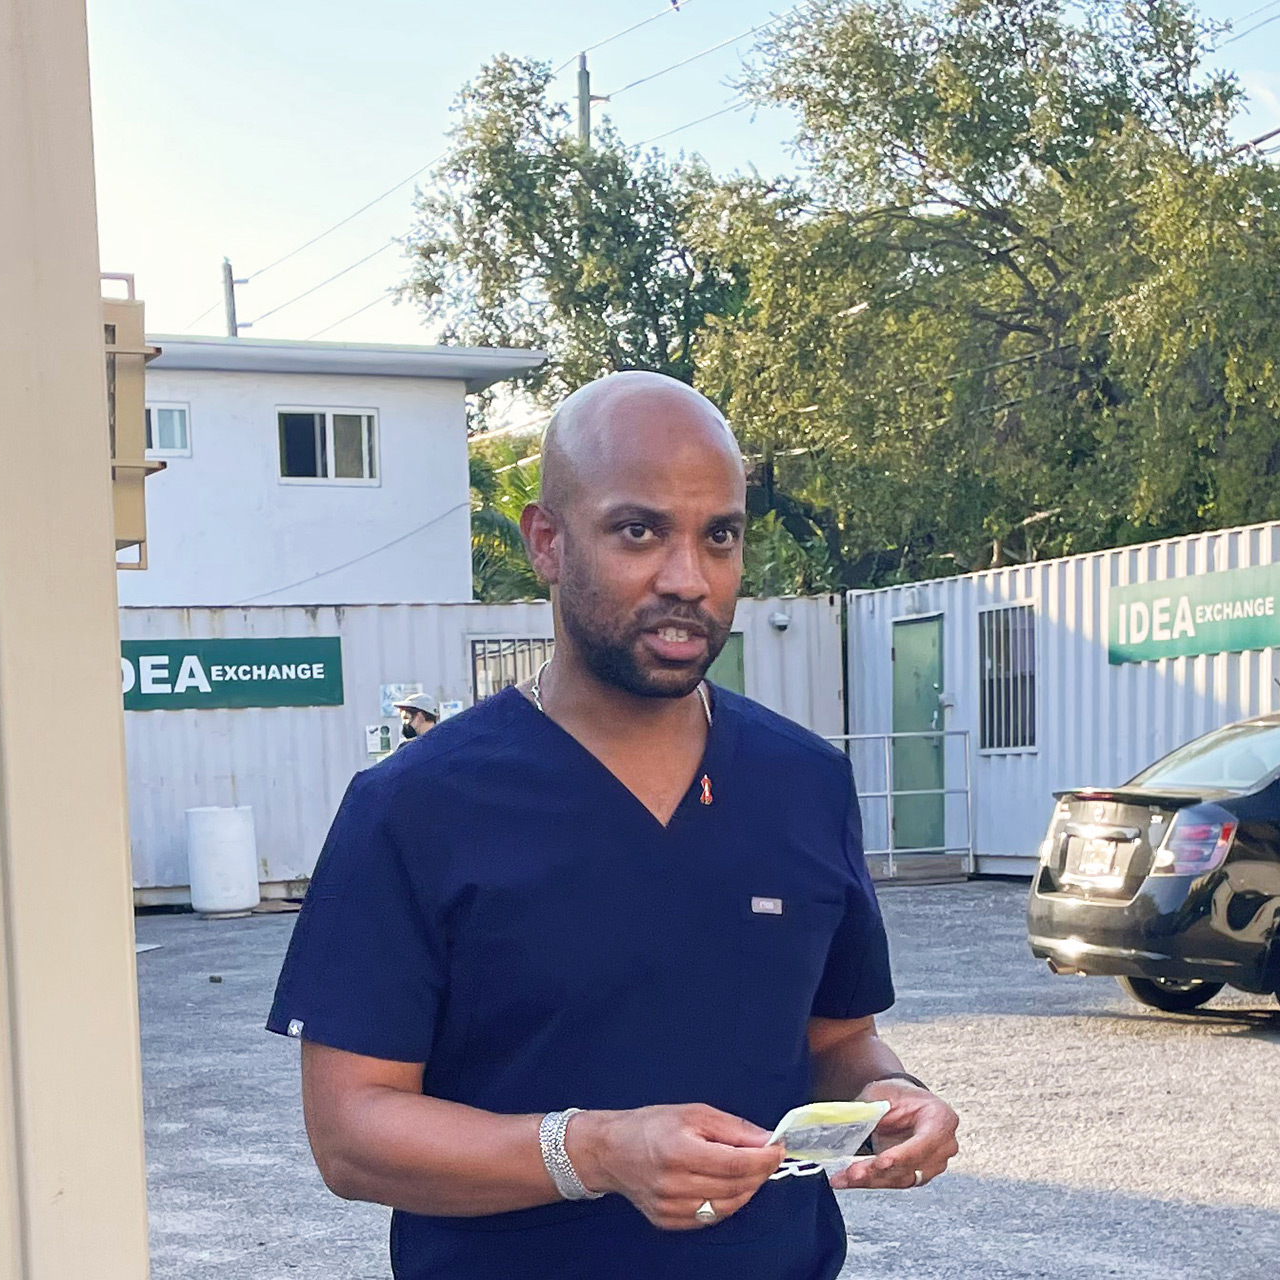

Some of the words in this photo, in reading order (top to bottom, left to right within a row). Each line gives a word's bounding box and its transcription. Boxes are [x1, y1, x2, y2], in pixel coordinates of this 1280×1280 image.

[1118, 595, 1196, 645] IDEA
[1195, 596, 1275, 624] EXCHANGE
[210, 663, 325, 681] EXCHANGE
